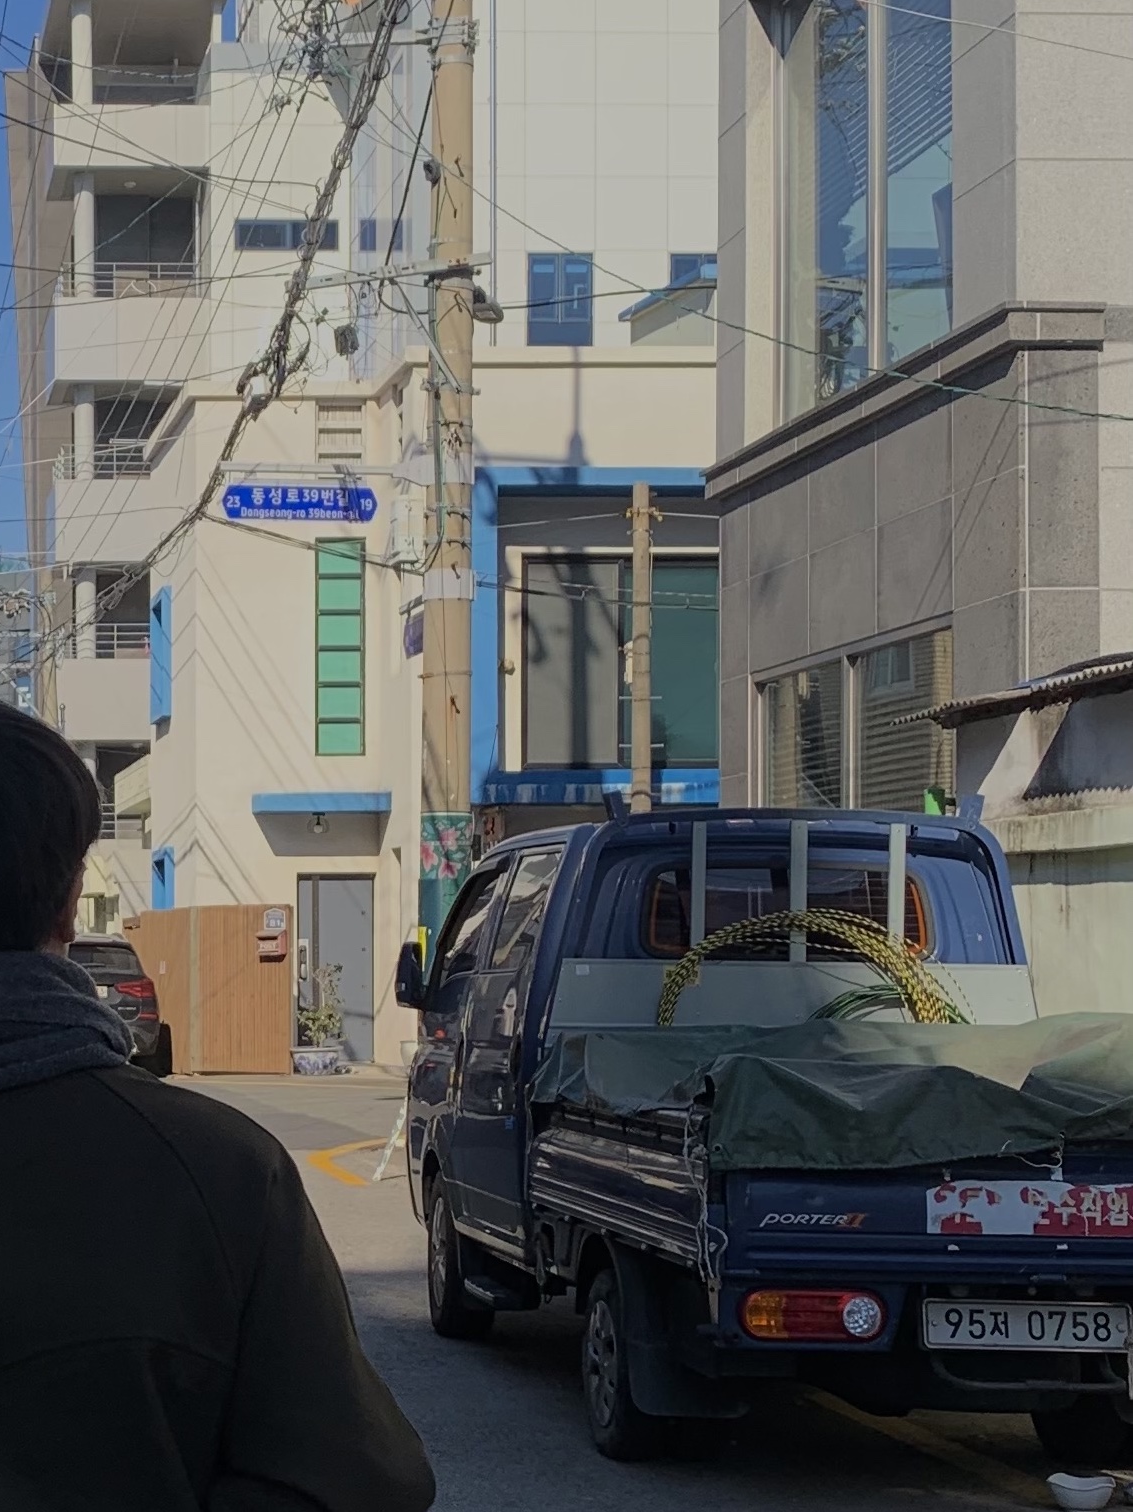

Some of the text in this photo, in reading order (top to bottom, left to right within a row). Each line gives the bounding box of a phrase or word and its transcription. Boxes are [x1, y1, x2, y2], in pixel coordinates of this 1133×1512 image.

[226, 495, 241, 508] 23
[359, 498, 373, 511] 19
[241, 506, 306, 519] Dongseong-ro
[944, 1308, 1111, 1342] 95저 0758
